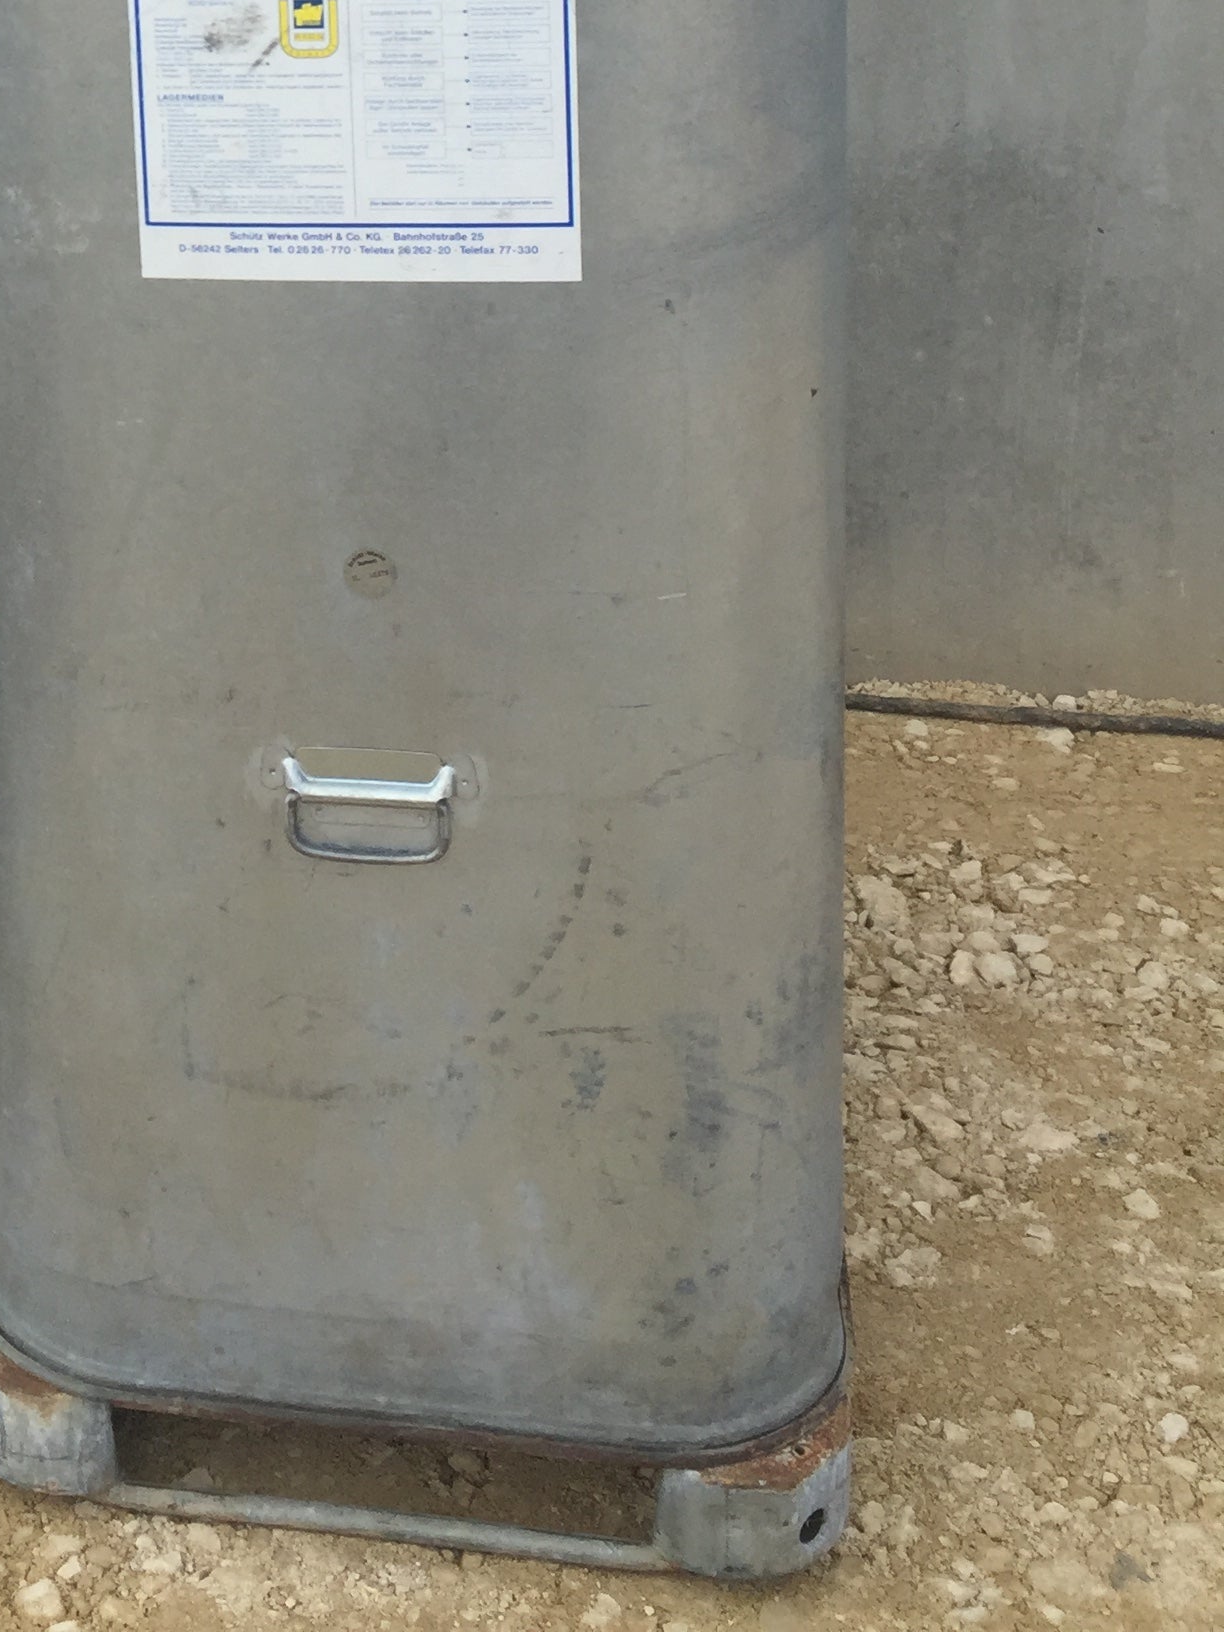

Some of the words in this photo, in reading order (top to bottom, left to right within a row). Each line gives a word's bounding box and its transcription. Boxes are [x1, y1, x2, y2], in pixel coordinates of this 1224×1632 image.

[229, 231, 263, 241] Schütz
[267, 232, 299, 241] Werke
[301, 232, 333, 241] GmbH
[335, 232, 343, 241] &
[393, 231, 467, 241] Bahnhofstraße
[471, 232, 484, 241] 25
[459, 245, 495, 254] Telefax
[499, 245, 539, 255] 77-330
